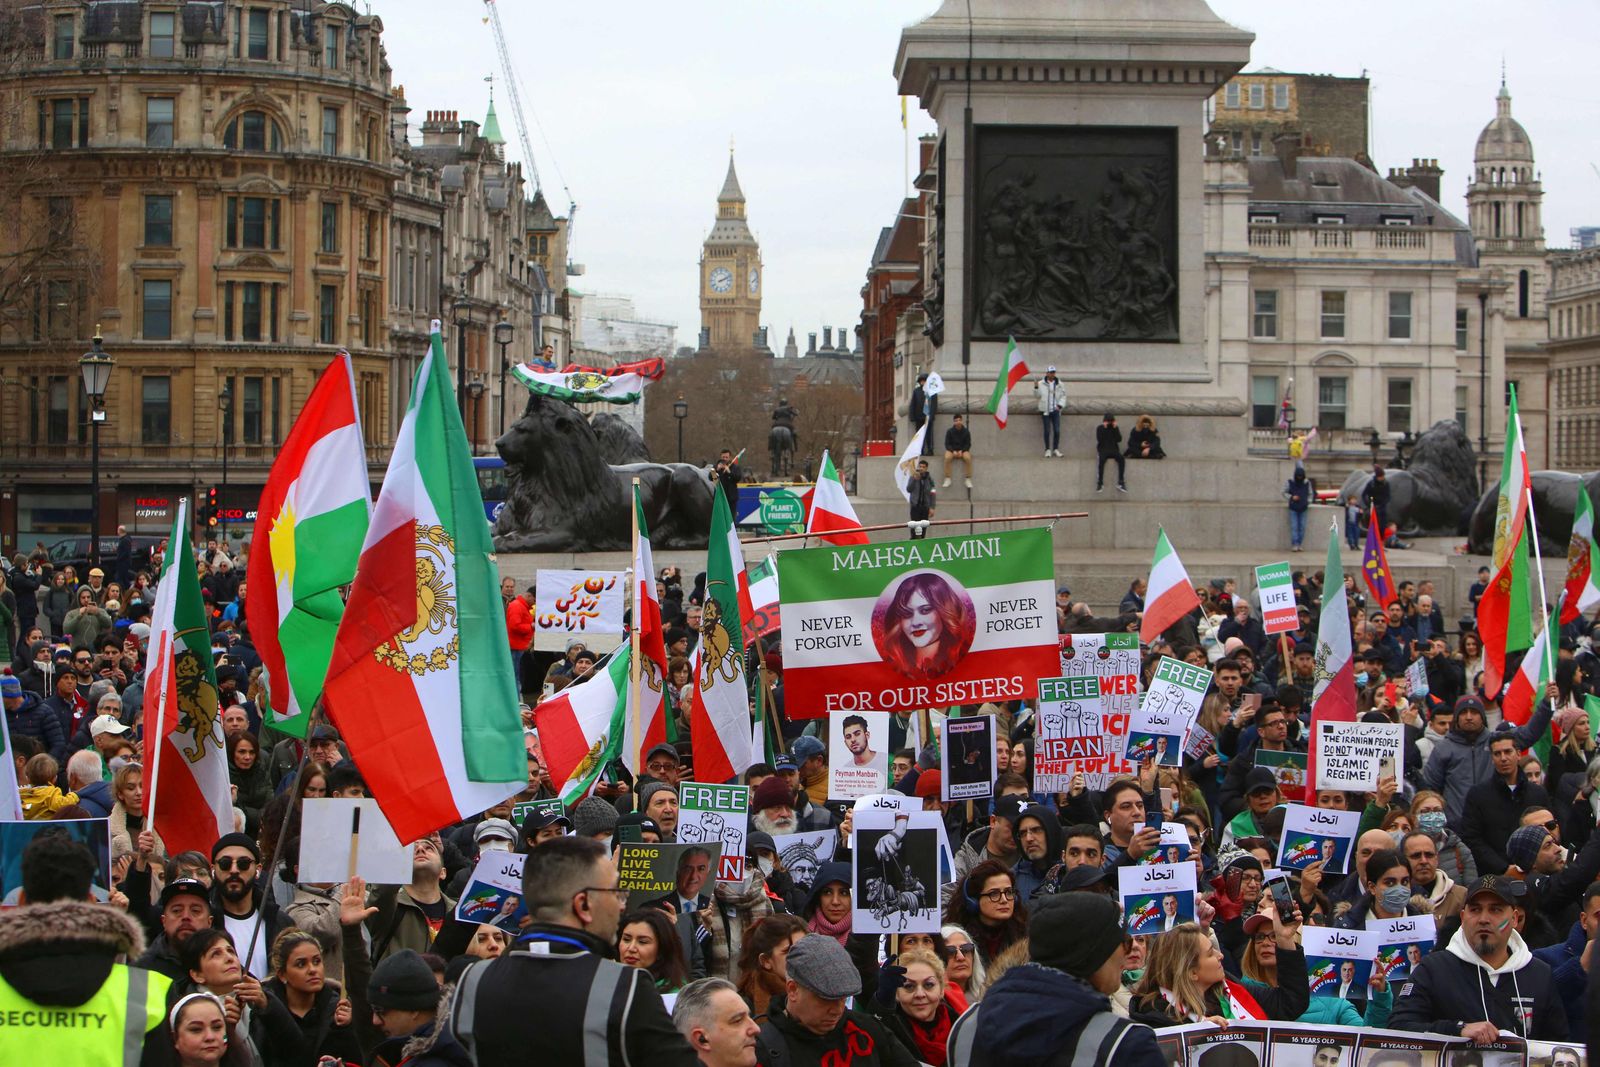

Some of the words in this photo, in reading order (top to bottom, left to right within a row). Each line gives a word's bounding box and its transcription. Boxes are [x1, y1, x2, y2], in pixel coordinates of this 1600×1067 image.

[135, 508, 167, 518] express
[767, 512, 797, 520] FRIENDLY
[832, 546, 924, 571] MAHSA
[929, 538, 1001, 563] AMINI
[1259, 570, 1290, 582] WOMAN
[584, 575, 617, 595] زن
[1266, 592, 1289, 605] LIFE
[989, 598, 1038, 615] NEVER
[801, 616, 853, 632] NEVER
[986, 616, 1043, 633] FORGET
[1265, 615, 1297, 626] FREEDOM
[795, 634, 862, 651] FORGIVE
[1156, 660, 1210, 692] FREE
[825, 692, 875, 712] FOR
[879, 687, 930, 709] OUR
[935, 676, 1024, 703] SISTERS
[1040, 678, 1098, 700] FREE
[1148, 715, 1170, 726] اتحاد
[1342, 736, 1373, 745] IRANIAN
[1374, 738, 1399, 747] PEOPLE
[1045, 737, 1104, 760] IRAN
[1324, 745, 1334, 754] DO
[1336, 746, 1352, 755] NOT
[1355, 747, 1381, 758] WANT
[1382, 749, 1394, 758] AN
[1326, 758, 1369, 770] ISLAMIC
[835, 769, 855, 778] Peyman
[1326, 769, 1372, 782] REGIME!
[681, 787, 747, 810] FREE
[873, 797, 900, 809] اتحاد
[1310, 811, 1339, 825] اتحاد
[623, 848, 659, 858] LONG
[622, 860, 651, 869] LIVE
[620, 870, 654, 880] REZA
[1144, 868, 1174, 882] اتحاد
[619, 880, 674, 891] PAHLAVI
[1389, 921, 1416, 933] اتحاد
[1327, 932, 1358, 946] اتحاد
